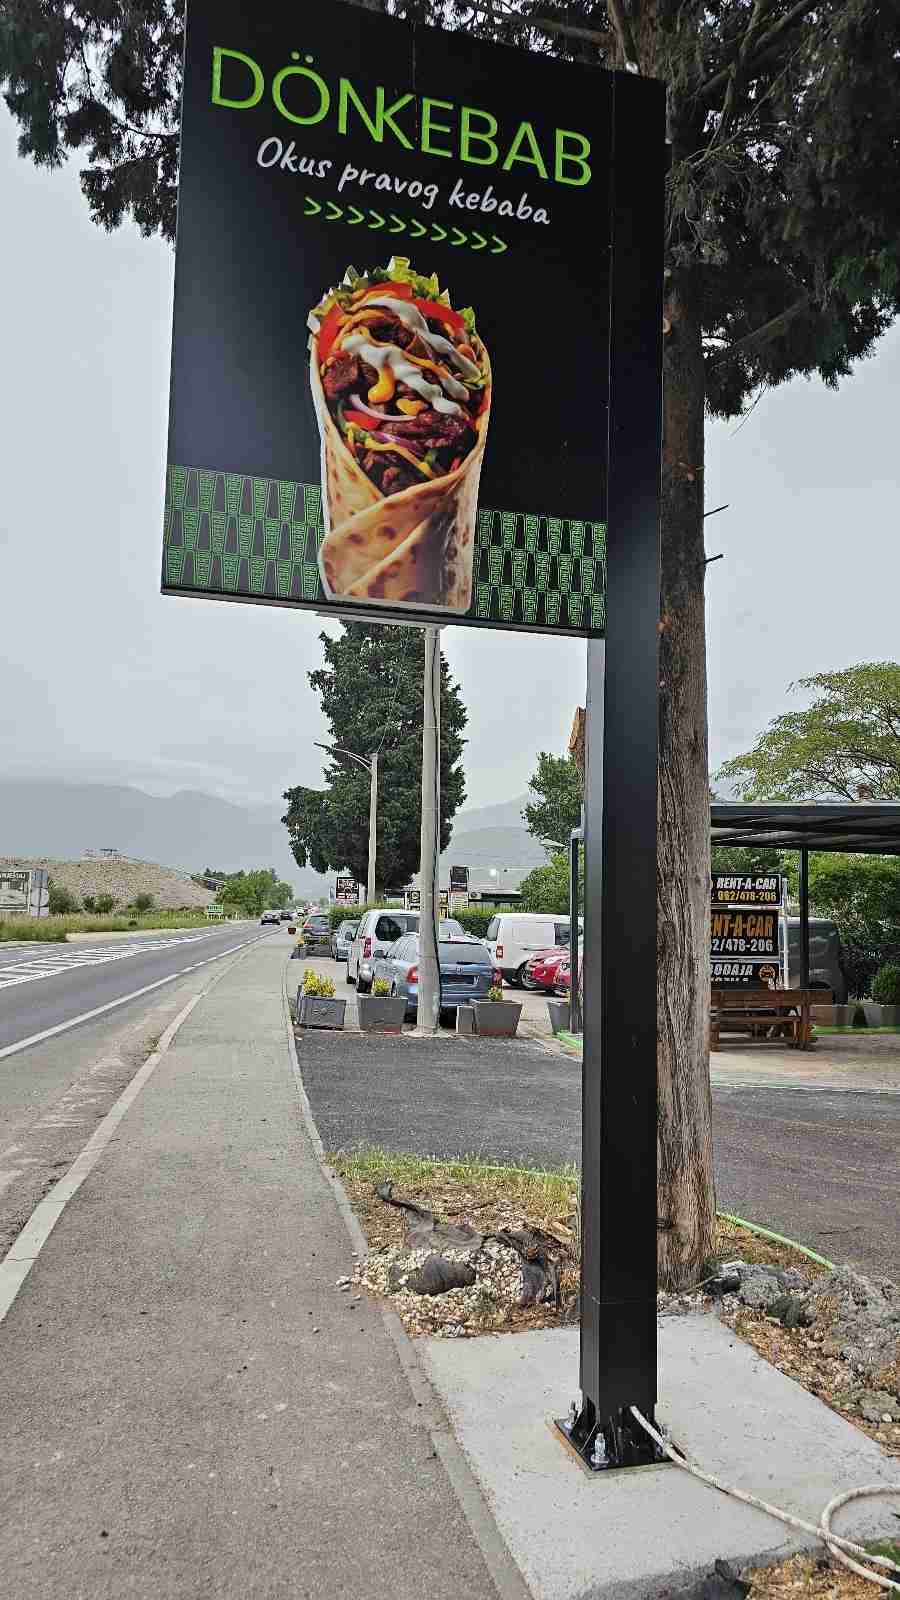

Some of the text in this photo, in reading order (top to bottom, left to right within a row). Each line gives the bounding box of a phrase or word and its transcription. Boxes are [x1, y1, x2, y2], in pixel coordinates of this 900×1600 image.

[211, 46, 592, 186] DÖNKEBAB
[256, 136, 551, 225] Okus pravog kebaba
[716, 877, 777, 890] RENT-A-CAR
[711, 938, 774, 952] 2/478-206
